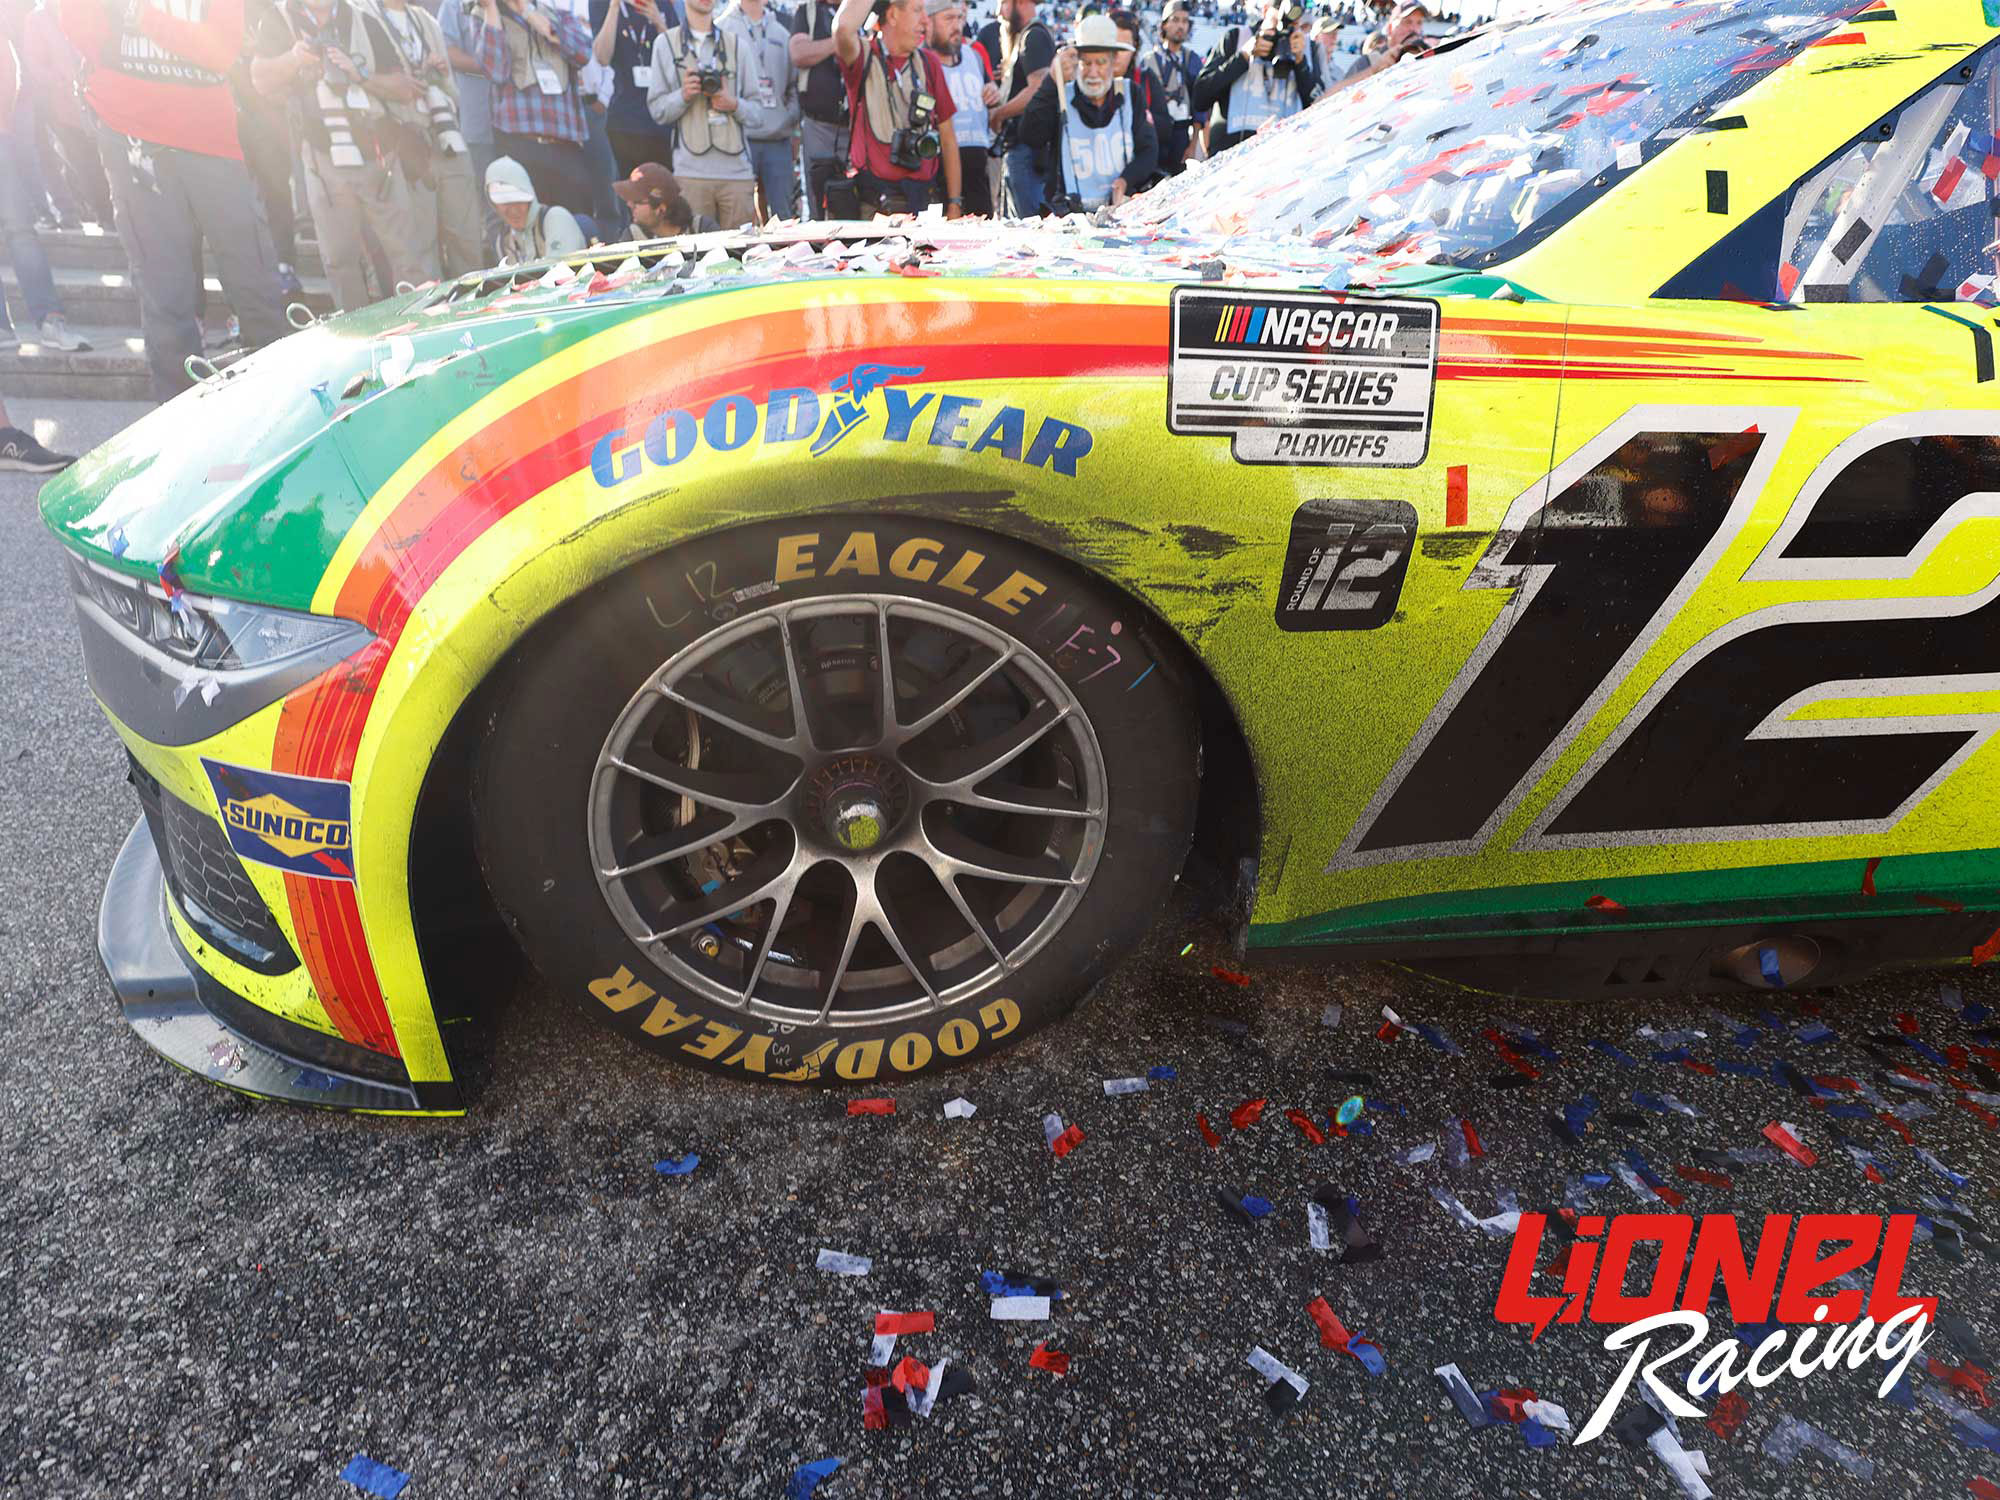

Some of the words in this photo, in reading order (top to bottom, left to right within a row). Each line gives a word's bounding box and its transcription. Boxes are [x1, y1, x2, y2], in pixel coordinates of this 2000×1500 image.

[1259, 306, 1400, 350] NASCAR
[1209, 365, 1281, 401] CUP
[1281, 368, 1398, 406] SERIES
[1274, 432, 1389, 458] PLAYOFFS
[774, 532, 1047, 616] EAGLE
[1285, 566, 1314, 611] ROUND
[1308, 546, 1322, 565] OF
[1297, 523, 1406, 611] 12
[1323, 404, 2000, 875] 12
[229, 802, 348, 845] SUNOCO
